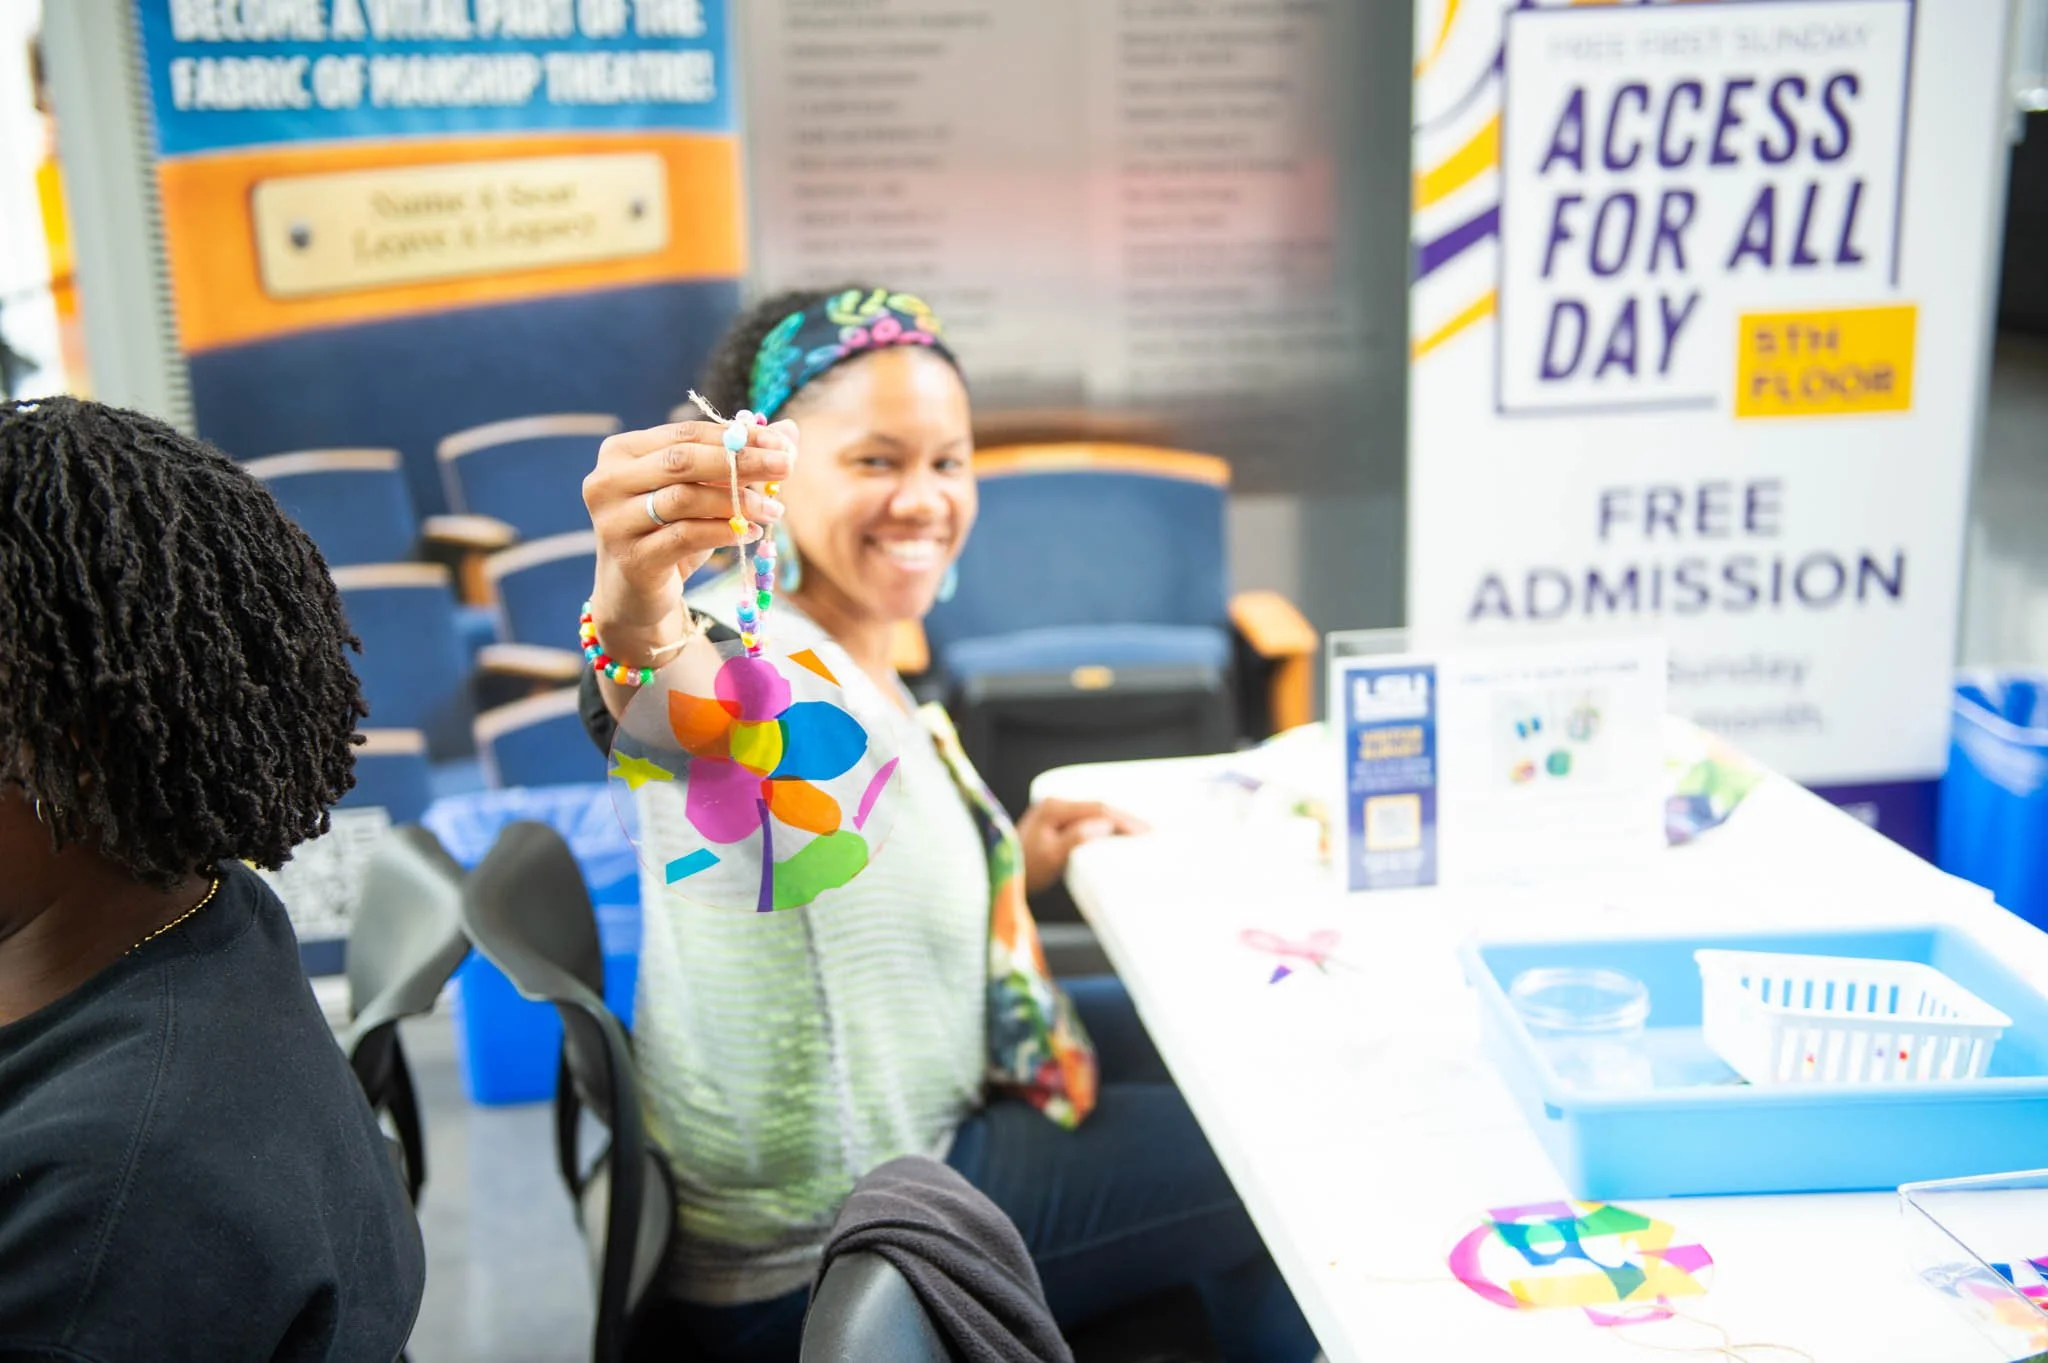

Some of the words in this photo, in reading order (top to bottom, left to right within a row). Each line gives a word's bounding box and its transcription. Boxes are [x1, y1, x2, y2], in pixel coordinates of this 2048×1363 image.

[168, 0, 328, 41] BECOME
[331, 0, 368, 41] A
[366, 0, 475, 40] VITAL
[476, 0, 576, 39] PART
[577, 0, 634, 39] OF
[633, 0, 707, 38] THE
[170, 56, 313, 111] FABRIC
[311, 55, 366, 109] OF
[367, 54, 545, 107] MANSHIP
[1538, 72, 1862, 175] ACCESS
[1541, 188, 1699, 280] FOR
[1725, 177, 1867, 273] ALL
[1538, 292, 1700, 382] DAY
[1754, 321, 1842, 359] 5TH
[1751, 362, 1896, 404] FLOOR
[1598, 478, 1784, 542] FREE
[1468, 549, 1908, 624] ADMISSION
